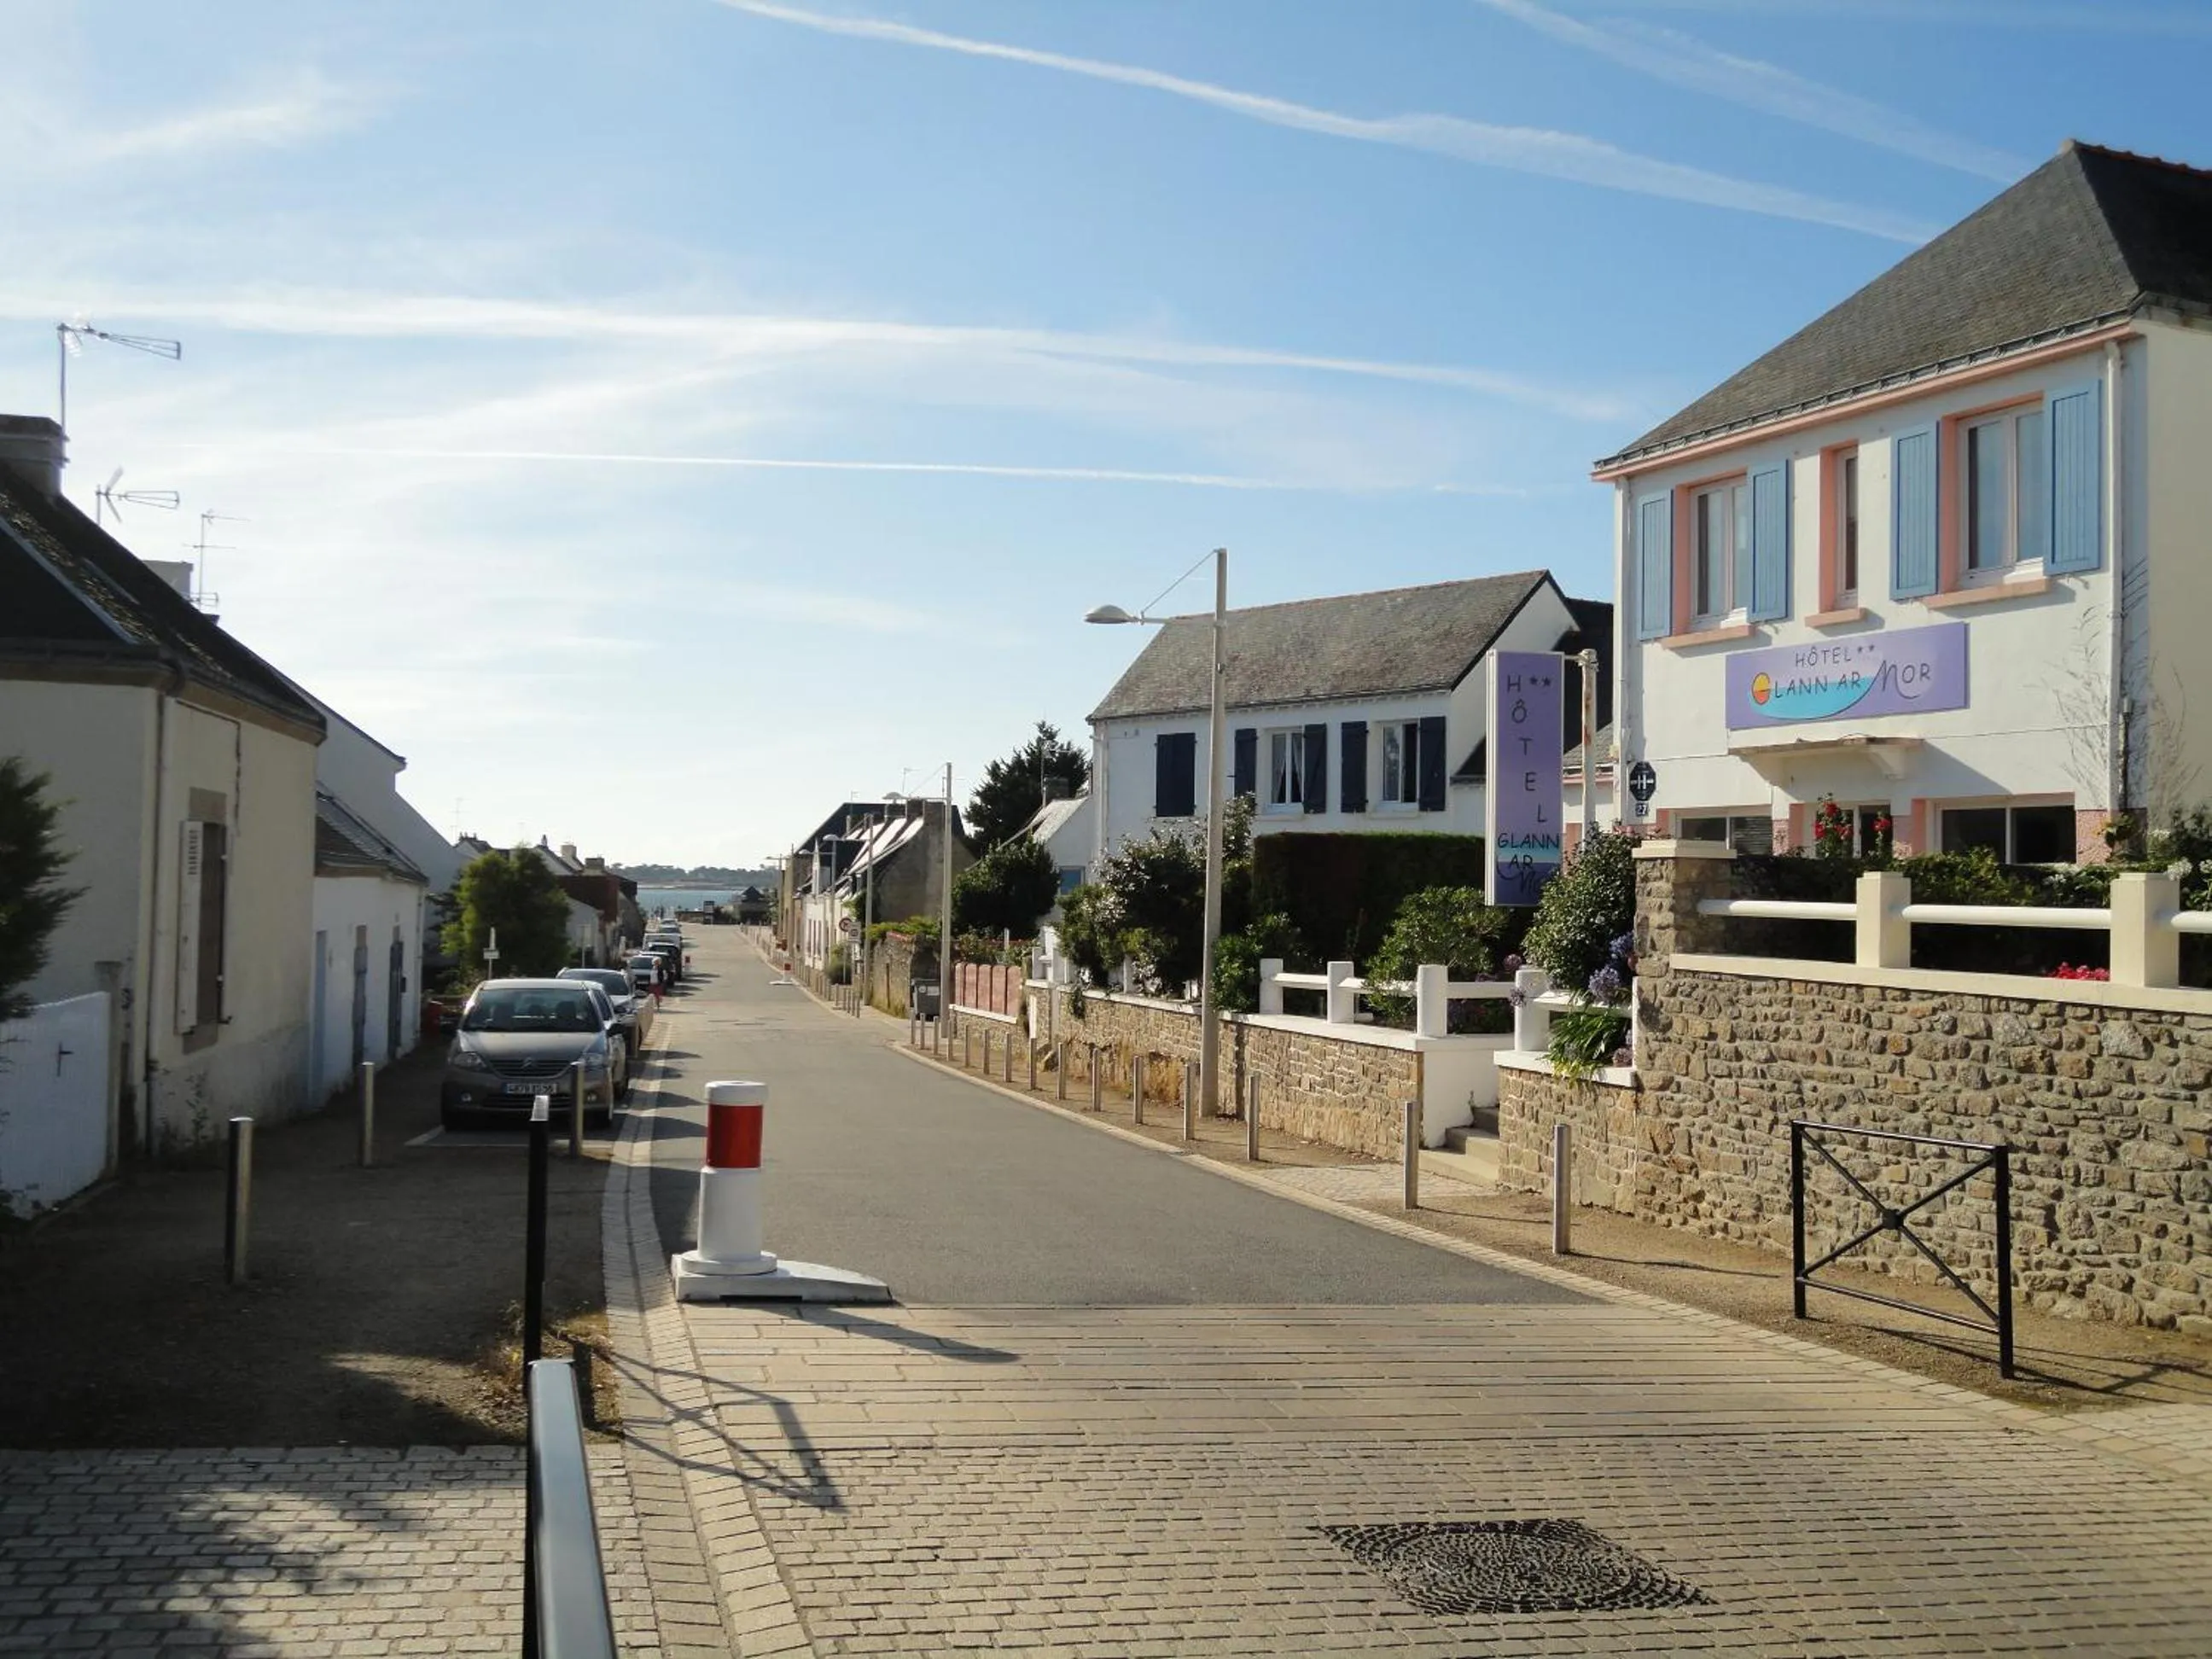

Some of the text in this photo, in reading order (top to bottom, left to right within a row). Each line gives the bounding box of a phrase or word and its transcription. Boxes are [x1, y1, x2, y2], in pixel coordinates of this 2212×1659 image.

[1795, 646, 1852, 667] HÔTEL
[1837, 672, 1861, 691] AR
[1873, 660, 1932, 700] MOR
[1497, 832, 1560, 849] GLANN
[1508, 854, 1534, 870] AR
